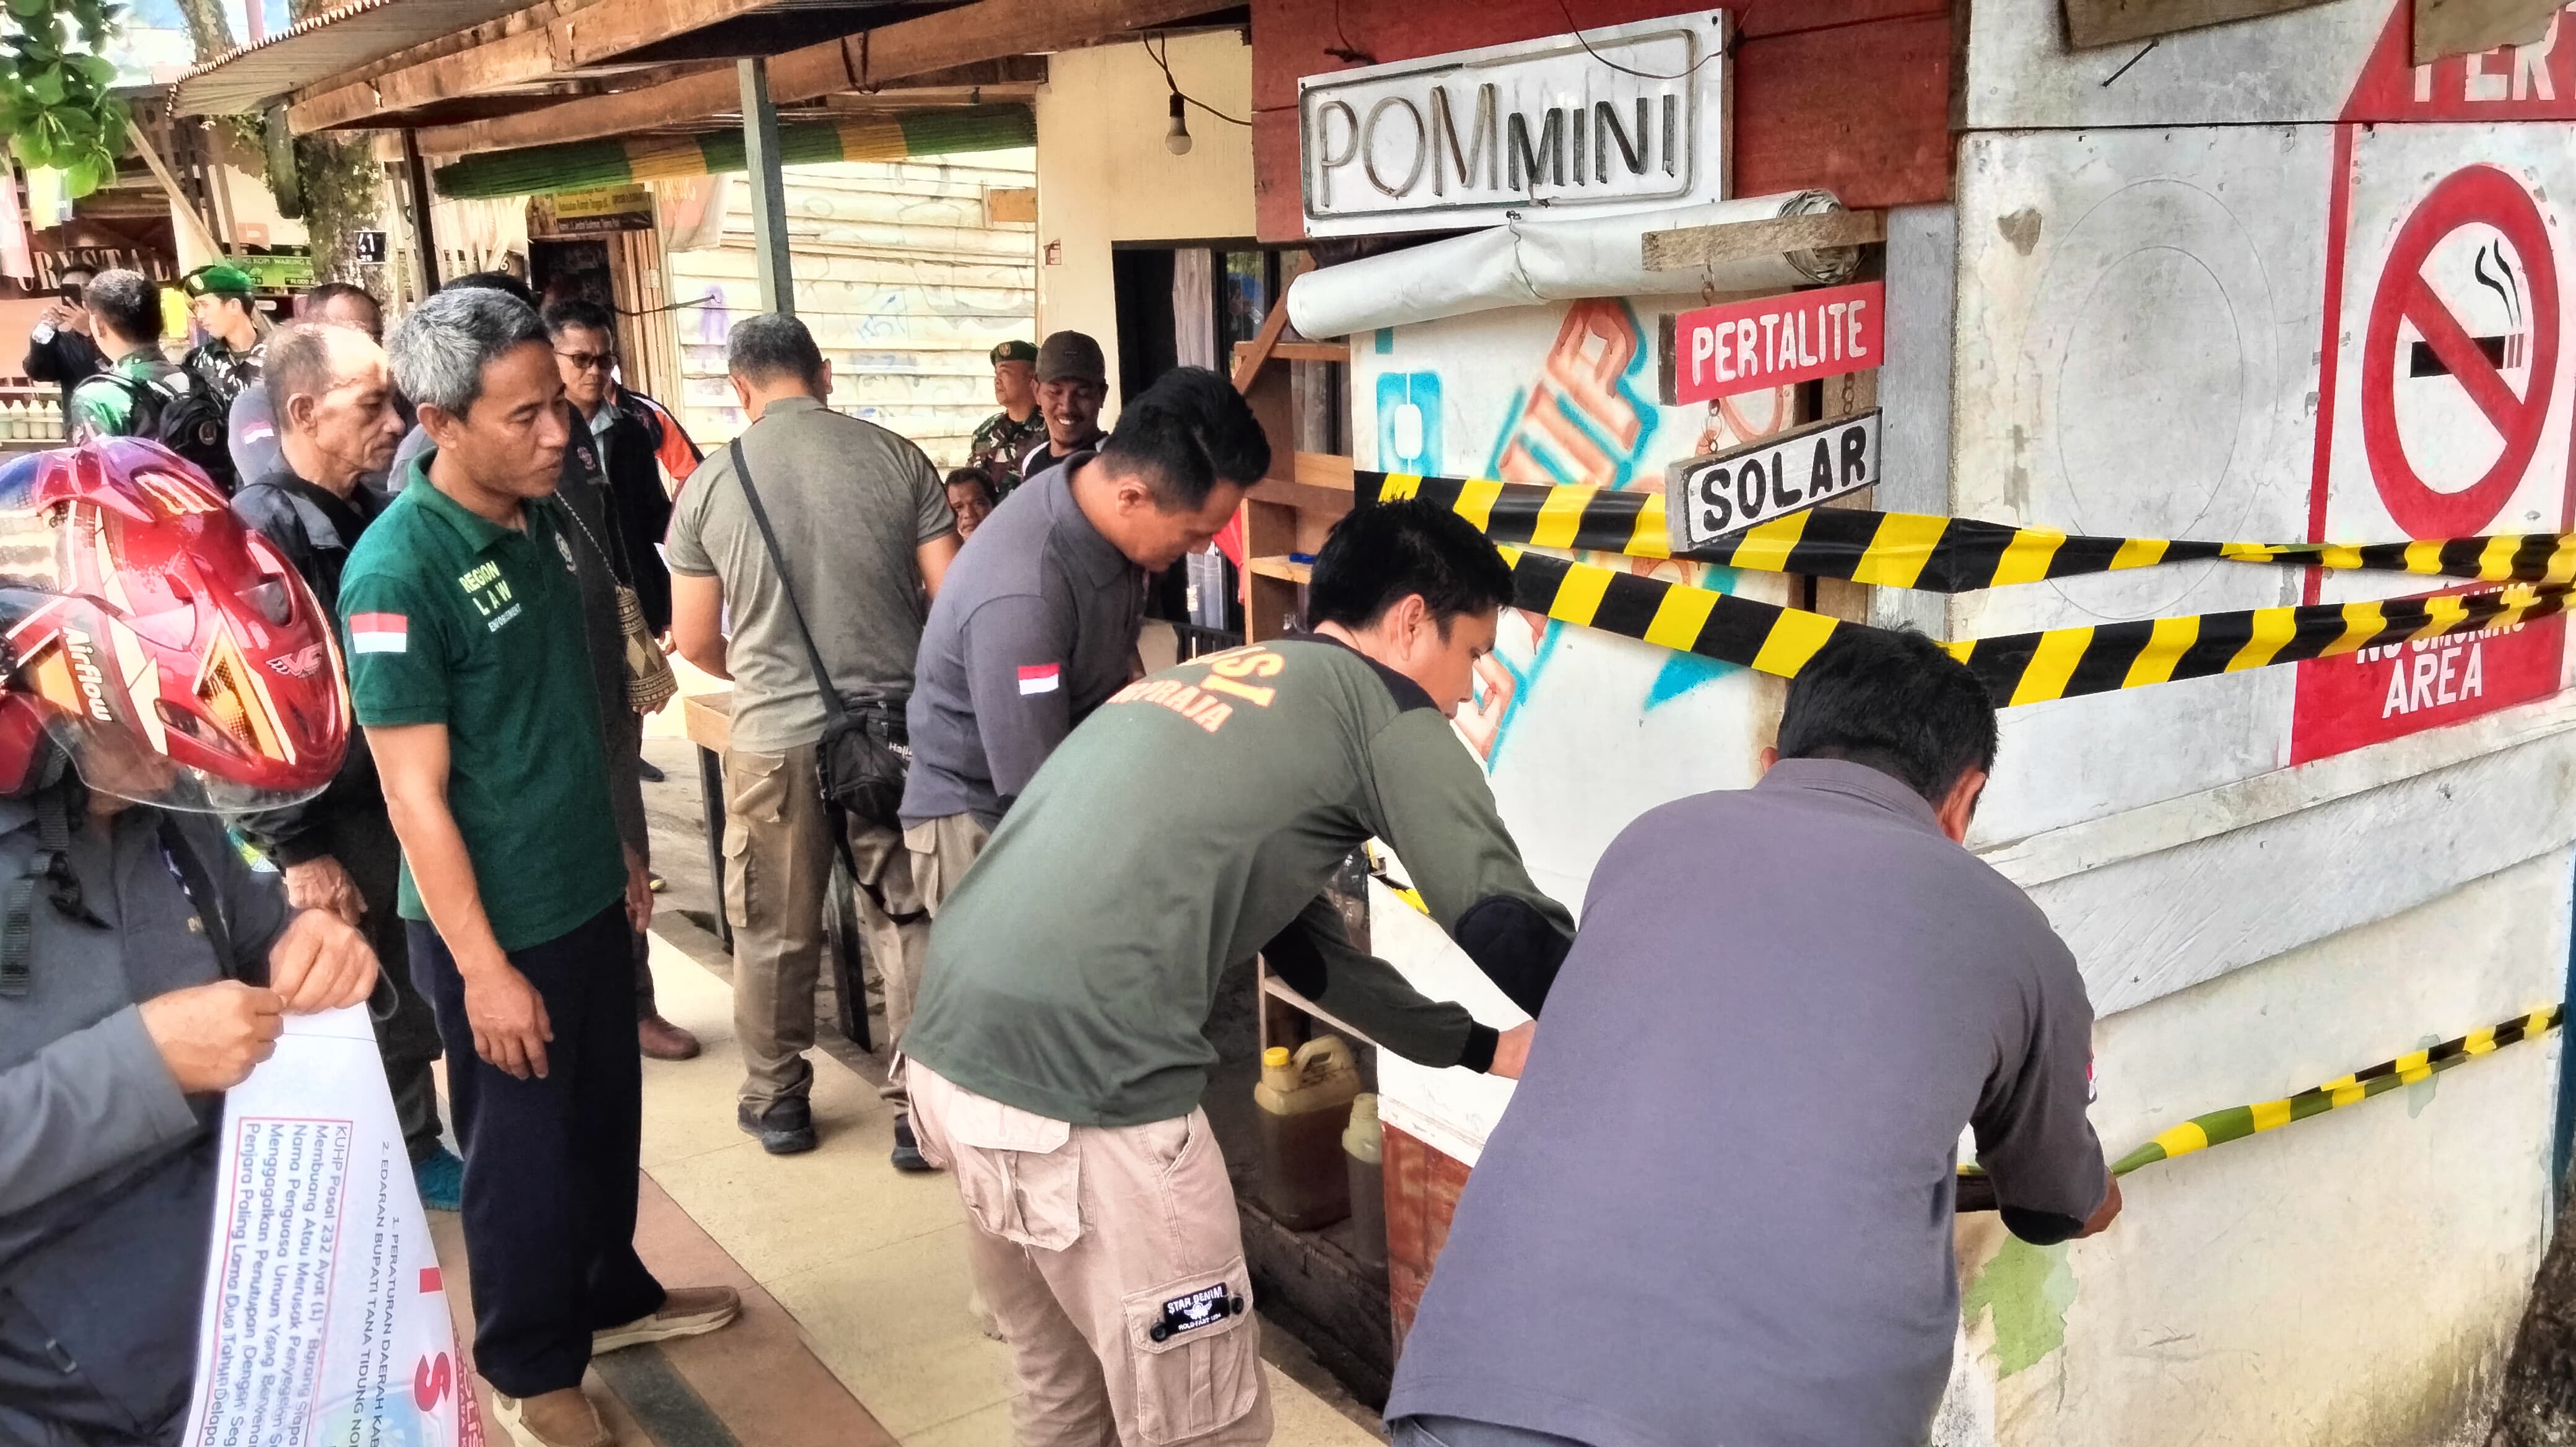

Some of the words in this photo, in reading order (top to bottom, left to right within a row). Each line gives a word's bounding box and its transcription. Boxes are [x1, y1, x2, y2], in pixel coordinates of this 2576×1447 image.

[1318, 82, 1499, 208] POM
[1508, 94, 1675, 192] MINI
[1691, 300, 1867, 387] PERTALITE
[1699, 426, 1867, 532] SOLAR
[458, 560, 500, 593] REGION
[472, 580, 512, 616] LAW
[2382, 642, 2482, 719] AREA
[240, 1123, 261, 1184] Penjara
[289, 1124, 308, 1171] Nama
[302, 1125, 329, 1212] Membuang
[332, 1126, 347, 1171] KUHP
[257, 1124, 284, 1242] Menggagalkan
[324, 1175, 341, 1218] Pasal
[376, 1159, 389, 1228] EDARAN
[231, 1189, 255, 1239] Paling
[277, 1179, 301, 1257] Penguasa
[299, 1217, 316, 1256] Atau
[319, 1225, 334, 1253] 232
[269, 1264, 289, 1318] Umum
[313, 1259, 329, 1295] Ayat
[369, 1233, 383, 1293] BUPATI
[383, 1234, 399, 1334] PERATURAN
[289, 1262, 311, 1329] Merusak
[362, 1298, 376, 1345] TANA
[1167, 1297, 1191, 1315] STAR
[1193, 1286, 1223, 1303] DENIM
[354, 1349, 370, 1414] TIDUNG
[375, 1339, 391, 1410] DAERAH
